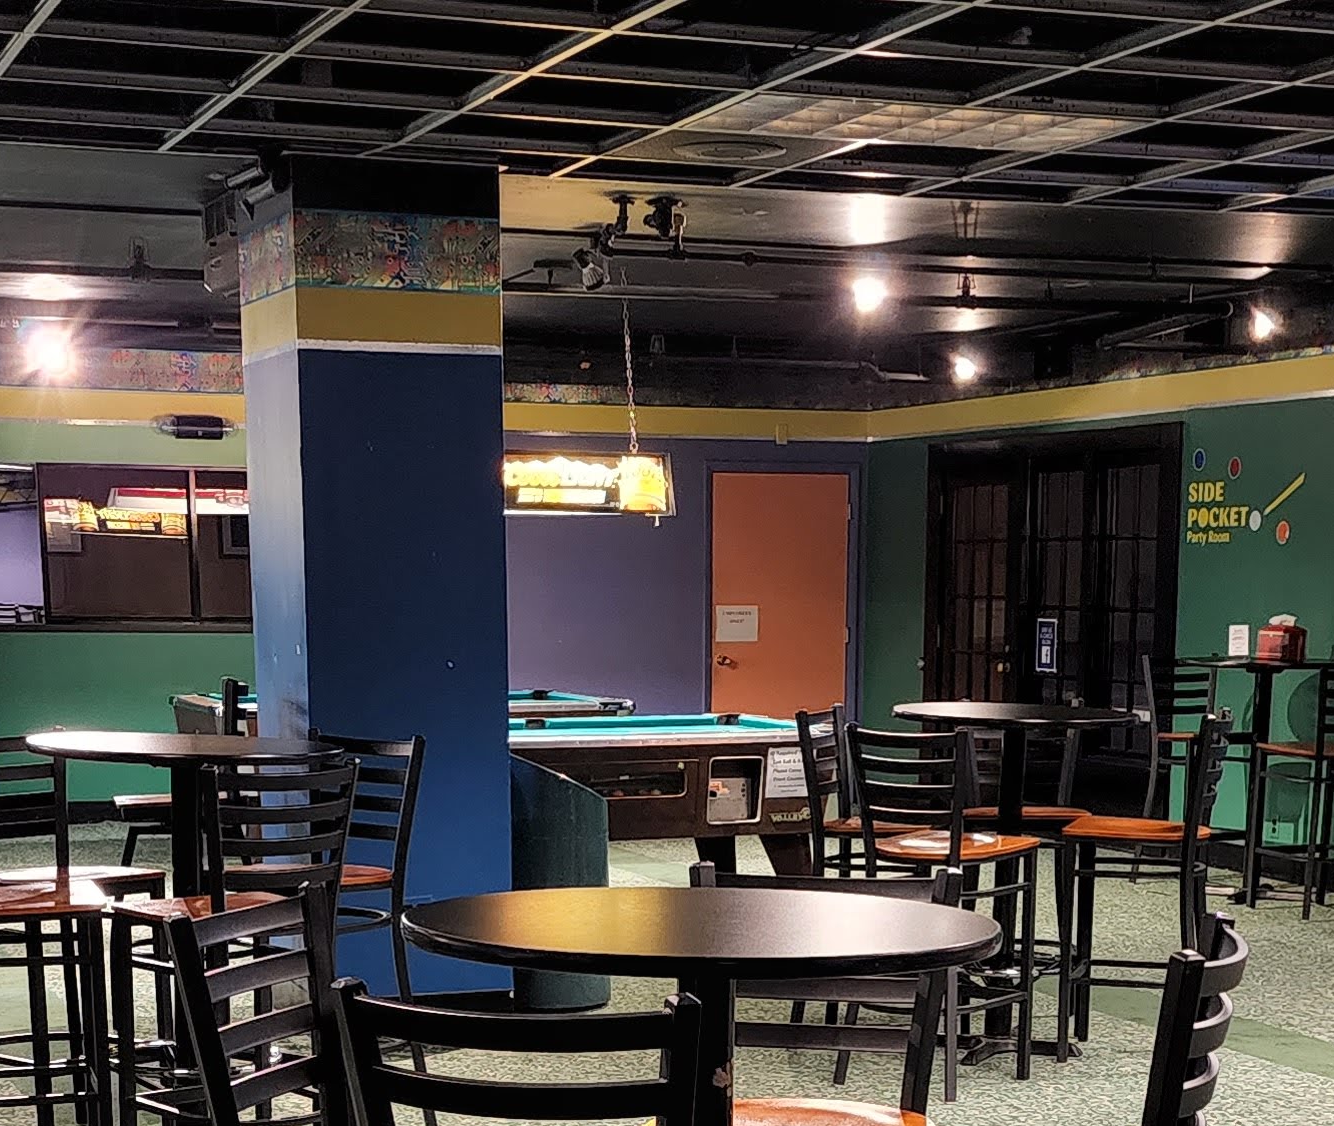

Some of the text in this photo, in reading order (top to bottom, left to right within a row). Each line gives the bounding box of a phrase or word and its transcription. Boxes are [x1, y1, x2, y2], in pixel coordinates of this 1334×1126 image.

[1188, 481, 1224, 502] SIDE
[1187, 506, 1249, 528] POCKET
[1186, 530, 1230, 547] Party Room
